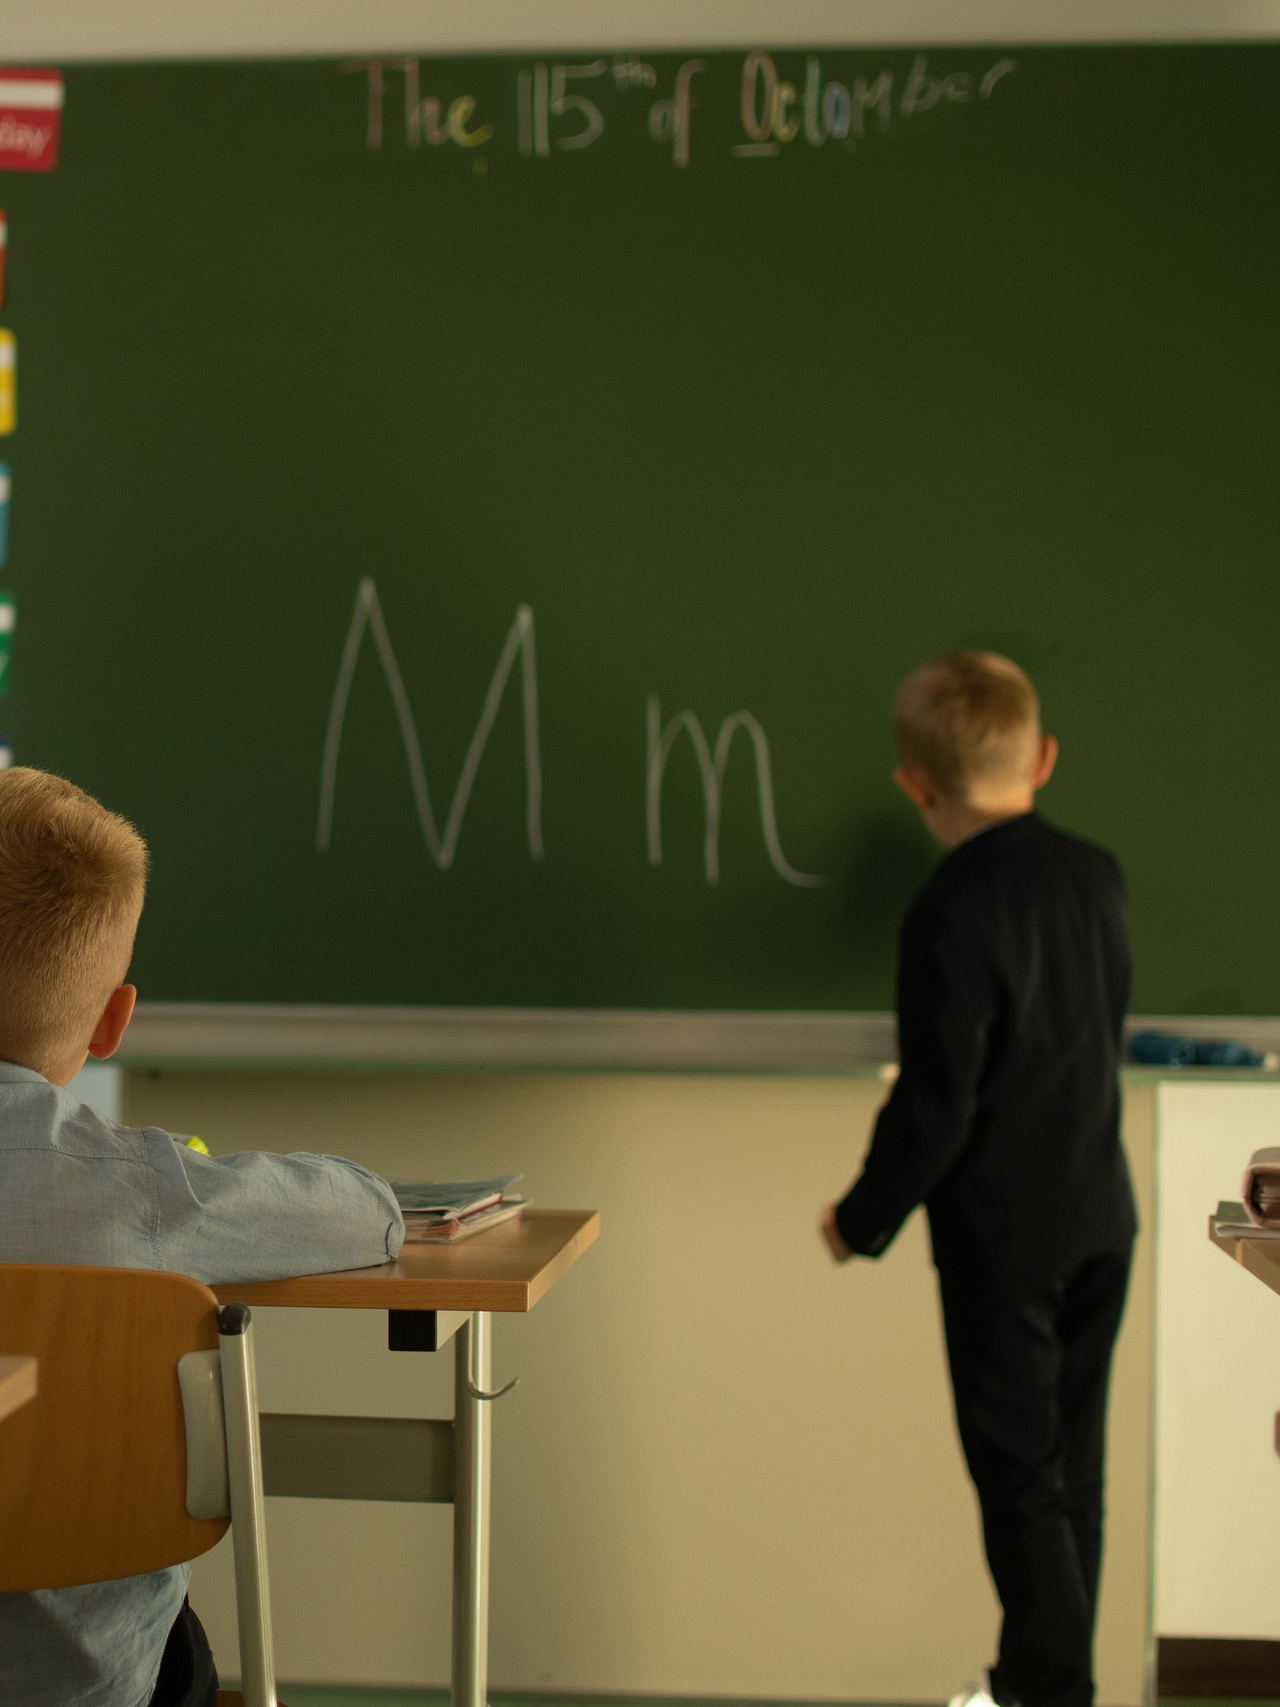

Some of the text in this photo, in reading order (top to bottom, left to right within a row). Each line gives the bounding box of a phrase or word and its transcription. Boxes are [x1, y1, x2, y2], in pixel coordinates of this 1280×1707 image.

[338, 57, 493, 151] The
[648, 59, 708, 168] of
[315, 574, 828, 888] M m
